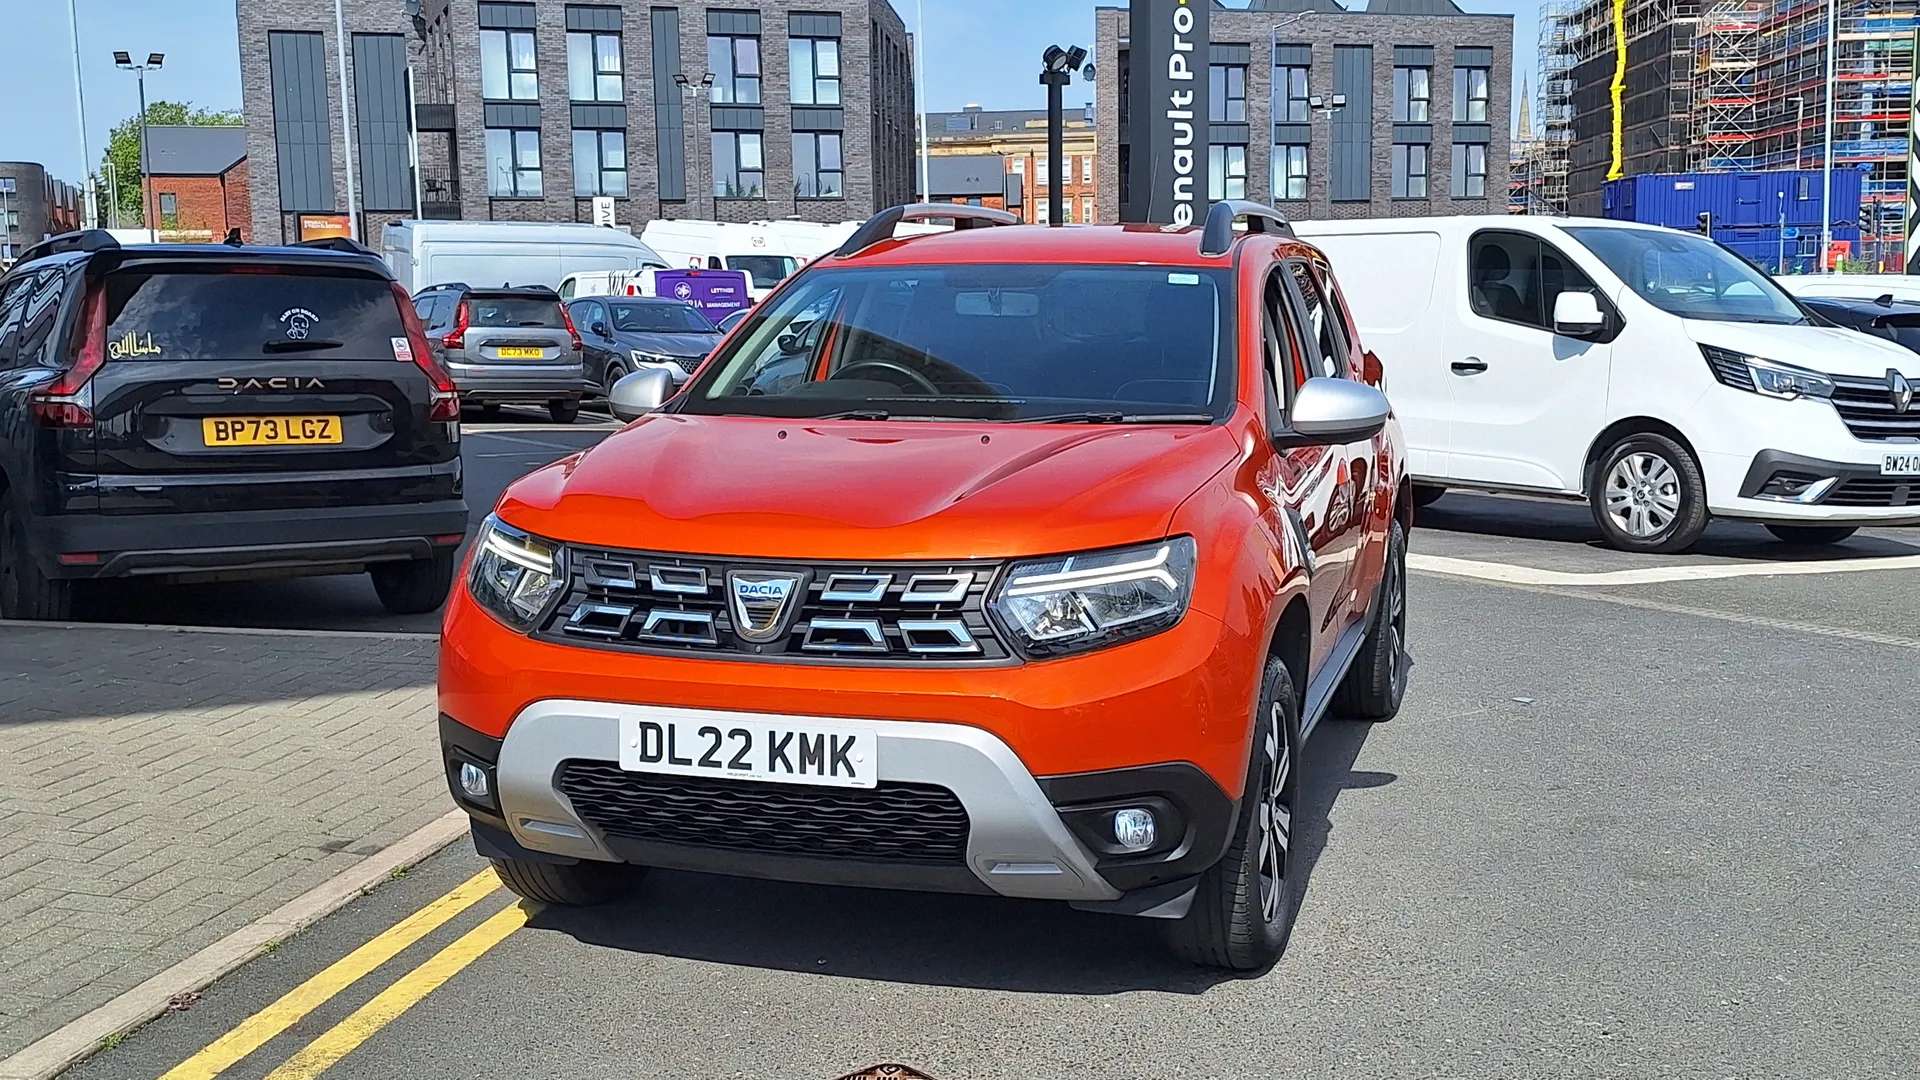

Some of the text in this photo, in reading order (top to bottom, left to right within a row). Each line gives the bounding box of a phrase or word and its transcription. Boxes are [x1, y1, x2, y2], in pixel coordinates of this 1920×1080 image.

[1166, 90, 1194, 226] enault
[601, 201, 611, 224] IVE
[218, 378, 325, 388] DACIA
[214, 418, 331, 441] BP73 LGZ
[1885, 455, 1910, 472] BW24
[740, 585, 783, 595] DACIA
[639, 721, 856, 778] DL22 KMK
